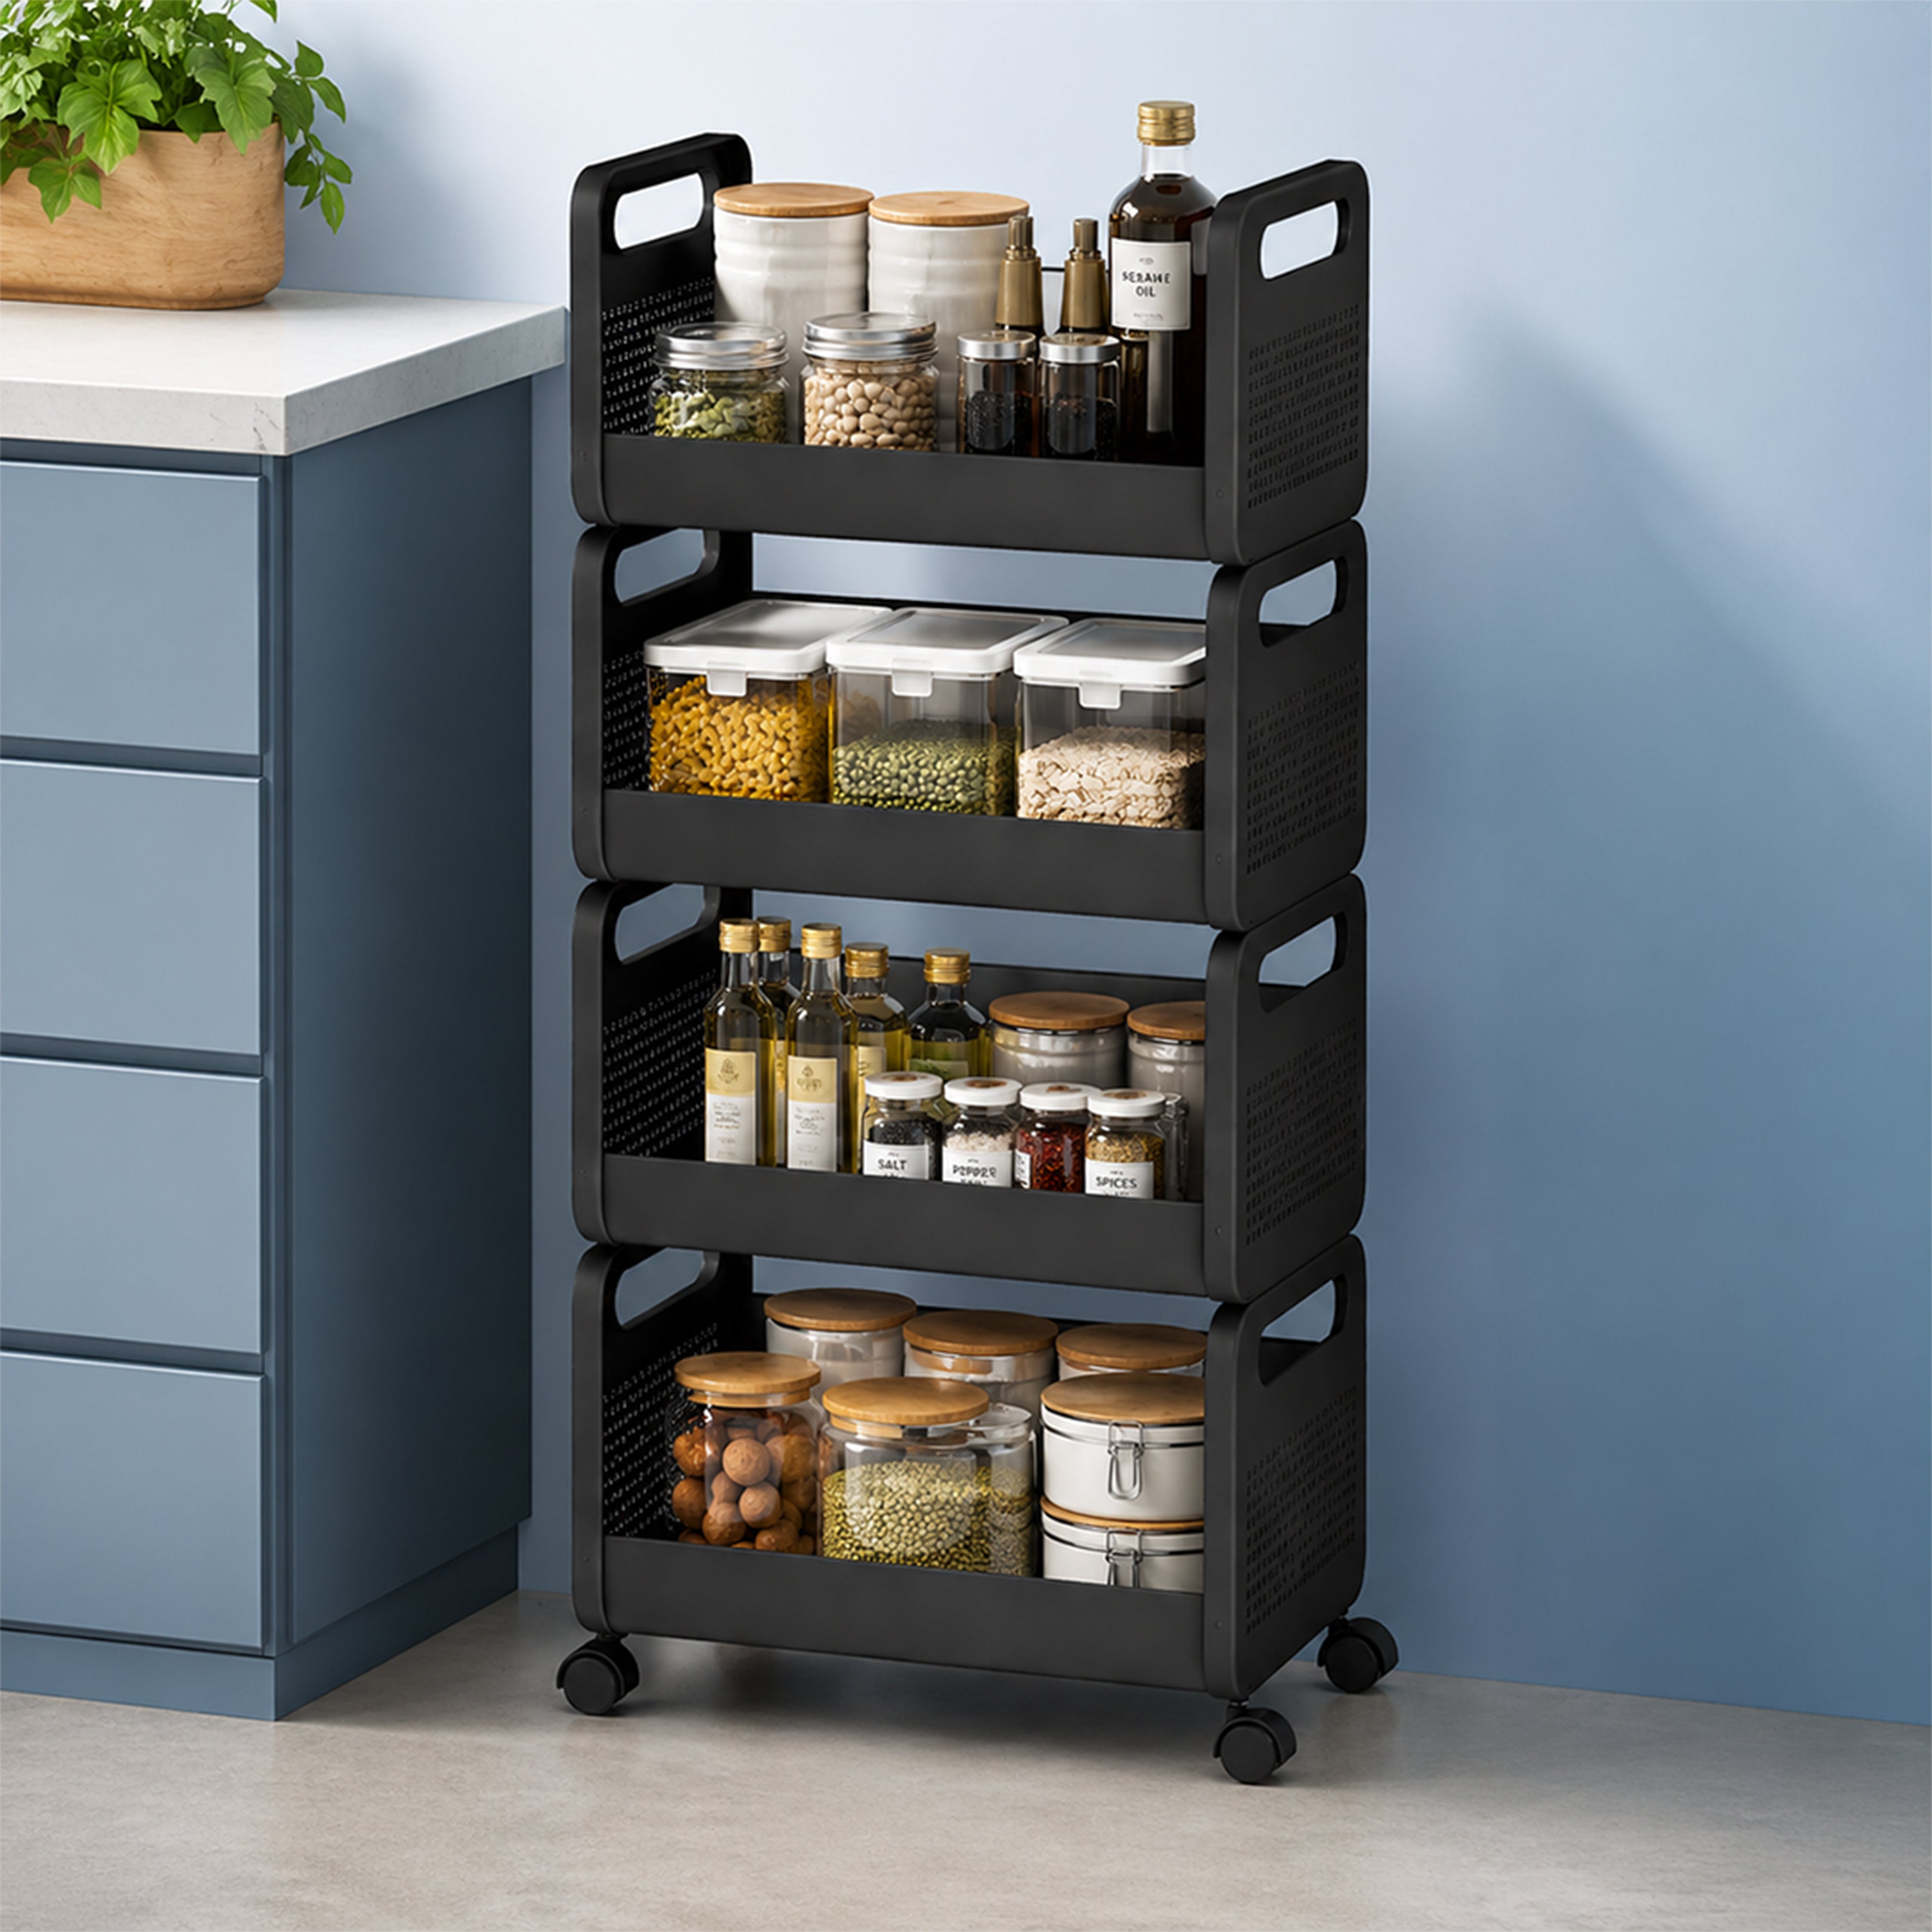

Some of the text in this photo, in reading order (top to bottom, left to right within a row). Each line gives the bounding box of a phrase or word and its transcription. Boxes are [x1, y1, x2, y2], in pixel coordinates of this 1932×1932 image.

[1135, 285, 1156, 298] OIL
[878, 1158, 907, 1171] SALT
[1096, 1175, 1137, 1189] SPICES
